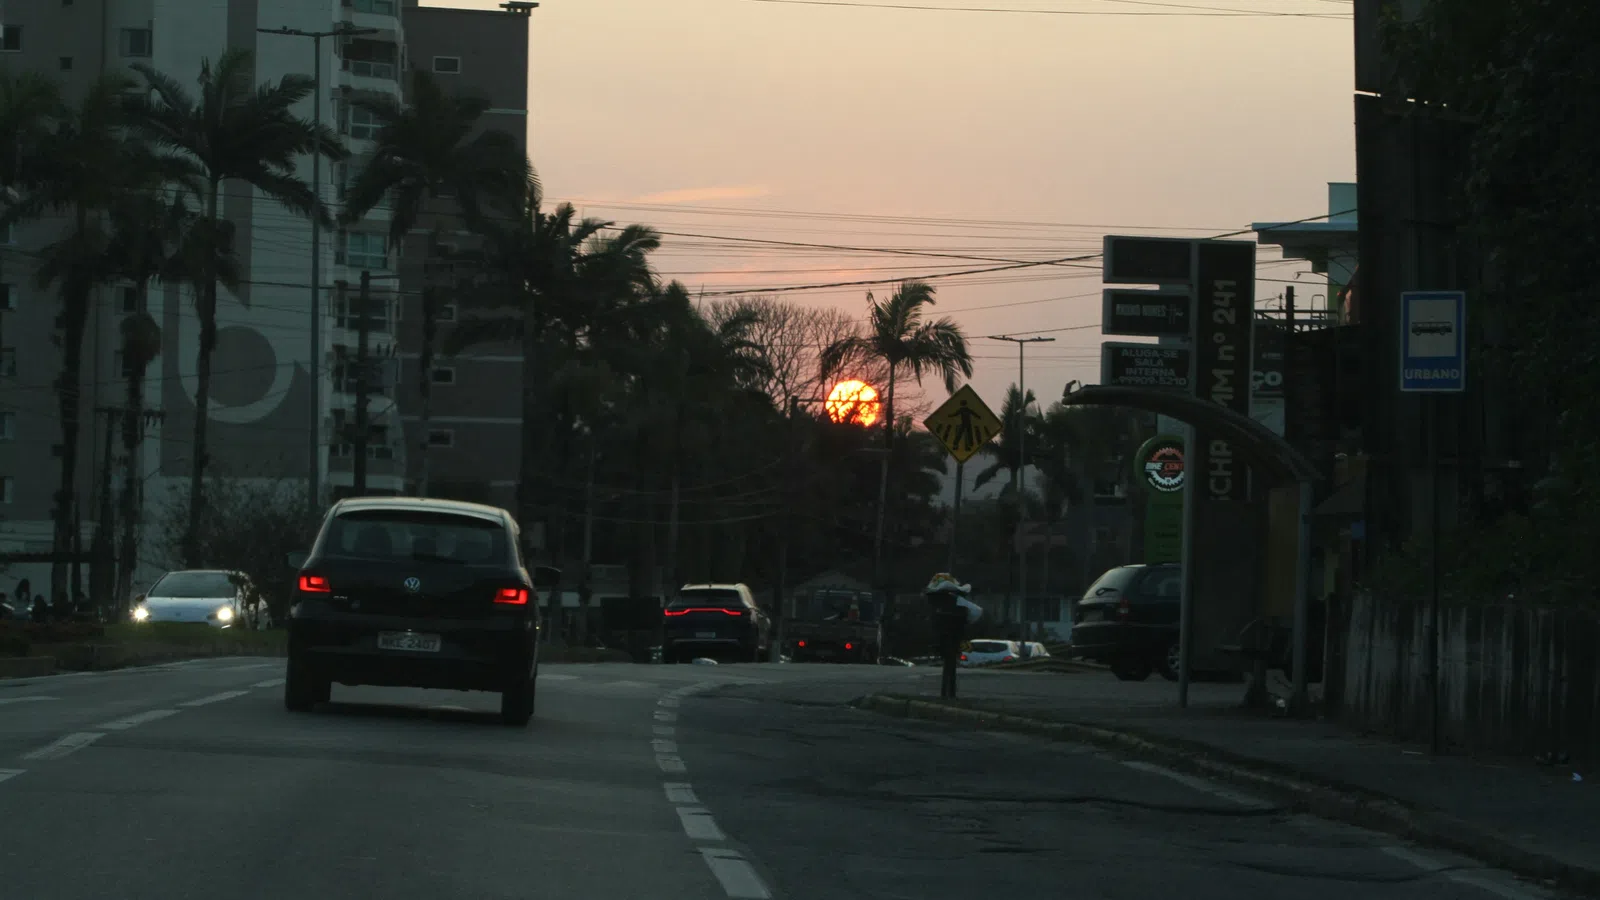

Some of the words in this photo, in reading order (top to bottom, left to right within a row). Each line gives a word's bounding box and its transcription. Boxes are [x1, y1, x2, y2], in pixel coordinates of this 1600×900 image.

[1213, 279, 1236, 324] 241
[1121, 348, 1179, 358] ALUGA-SE
[1134, 357, 1164, 367] SALA
[1125, 367, 1176, 377] INTERNA
[1404, 368, 1460, 380] URBANO
